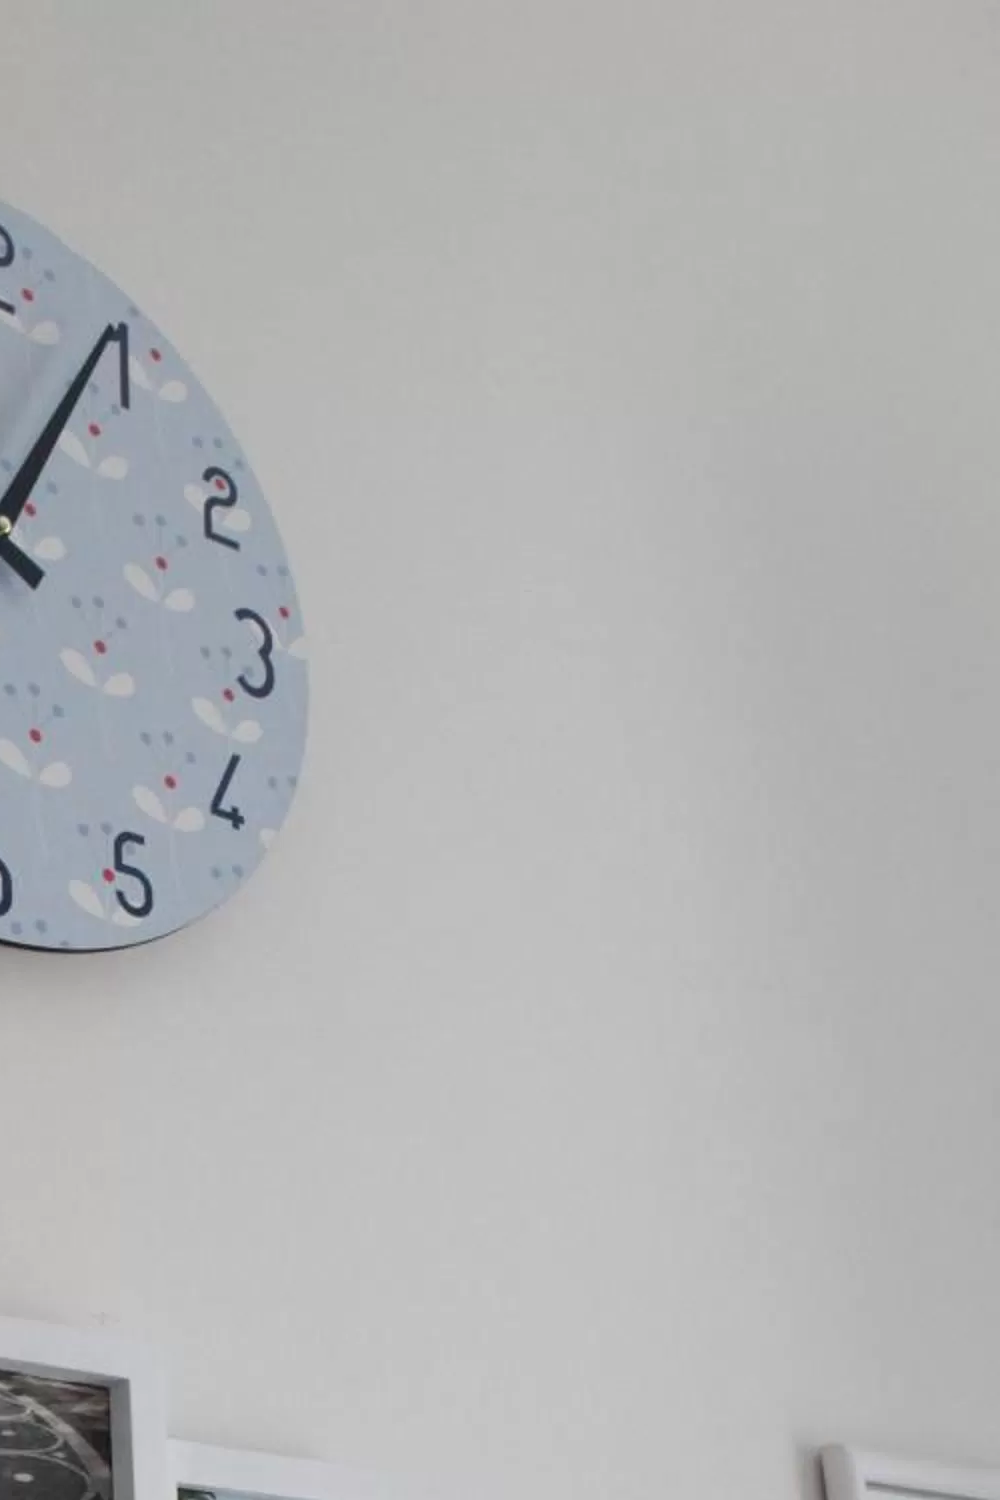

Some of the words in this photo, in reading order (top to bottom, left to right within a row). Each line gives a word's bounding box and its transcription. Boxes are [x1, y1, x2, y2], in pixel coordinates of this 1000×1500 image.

[106, 321, 130, 409] 1
[203, 466, 241, 551] 2
[234, 608, 276, 699] 3
[210, 754, 245, 830] 4
[113, 831, 154, 918] 5
